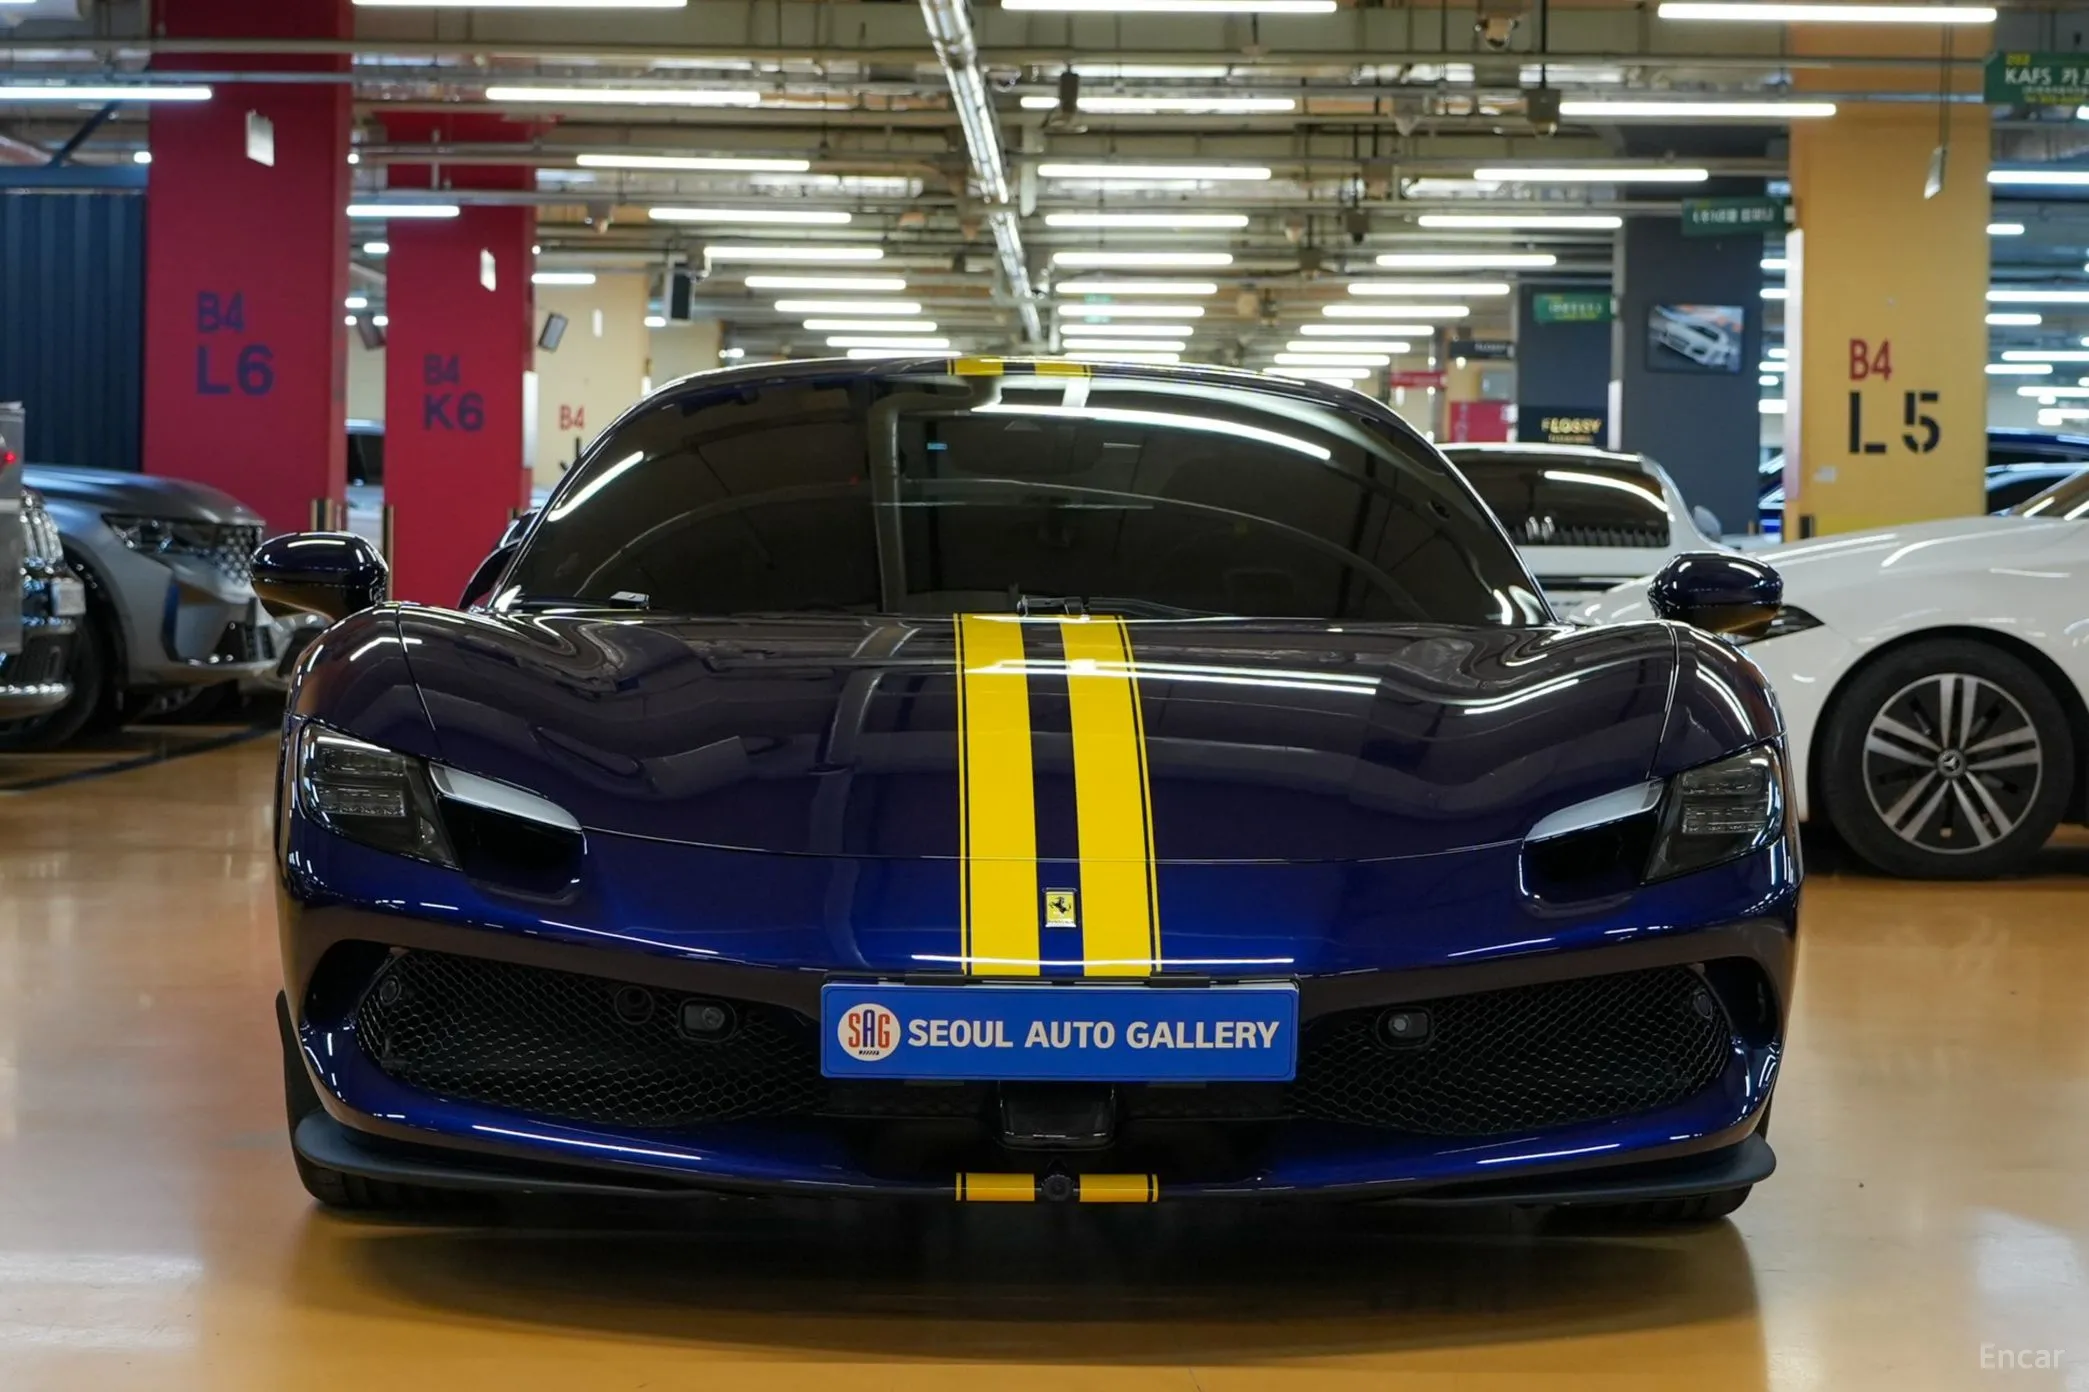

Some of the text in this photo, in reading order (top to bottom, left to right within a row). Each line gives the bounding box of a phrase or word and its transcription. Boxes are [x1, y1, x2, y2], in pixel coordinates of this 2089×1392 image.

[197, 290, 244, 333] B4
[197, 343, 275, 396] L6
[423, 354, 460, 385] B4
[1850, 338, 1892, 381] B4
[423, 391, 484, 431] K6
[559, 404, 585, 431] B4
[848, 1009, 891, 1048] SAG
[908, 1019, 1279, 1049] SEOUL AUTO GALLERY
